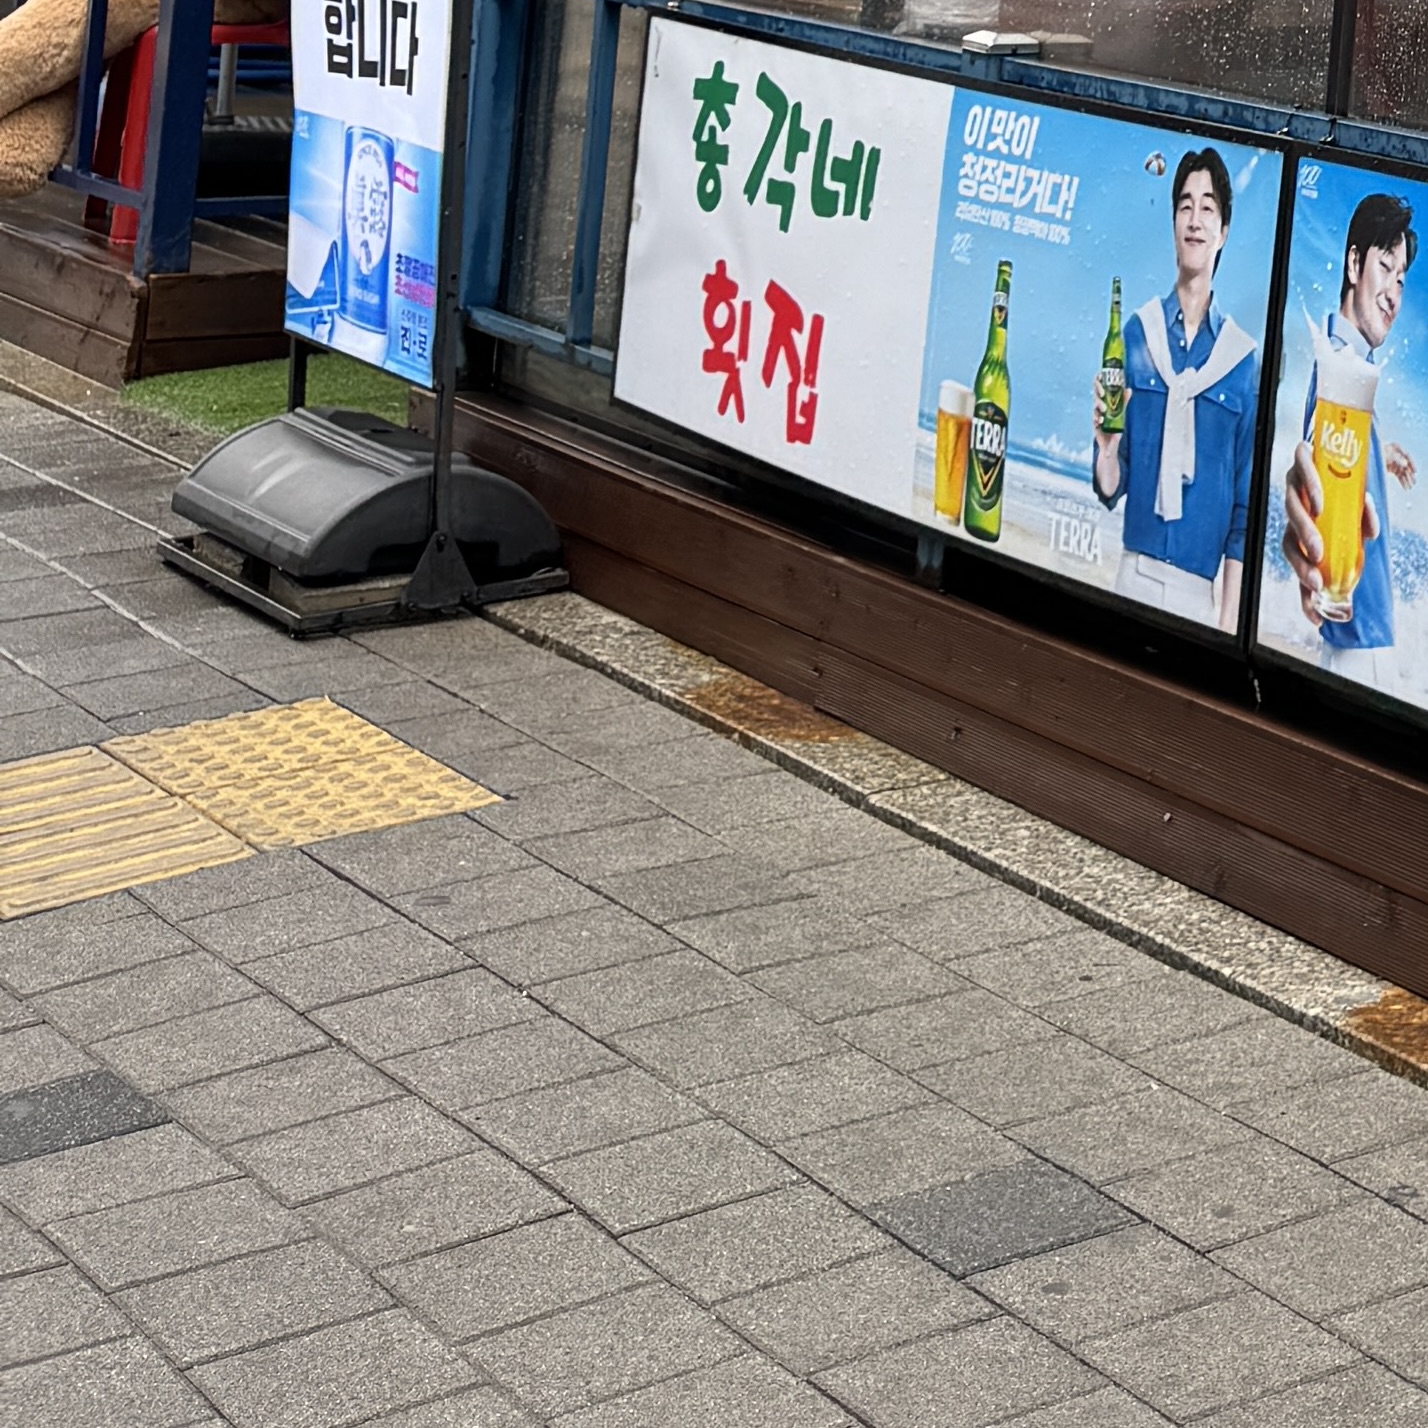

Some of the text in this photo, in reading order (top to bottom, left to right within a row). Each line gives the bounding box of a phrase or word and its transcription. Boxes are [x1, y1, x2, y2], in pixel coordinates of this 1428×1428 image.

[691, 59, 881, 236] 총각네
[963, 104, 1041, 161] 이 맛이
[957, 151, 1080, 222] 청정라거다!
[702, 257, 826, 446] 횟집
[1319, 420, 1364, 468] Kelly
[1047, 510, 1103, 567] TERRA
